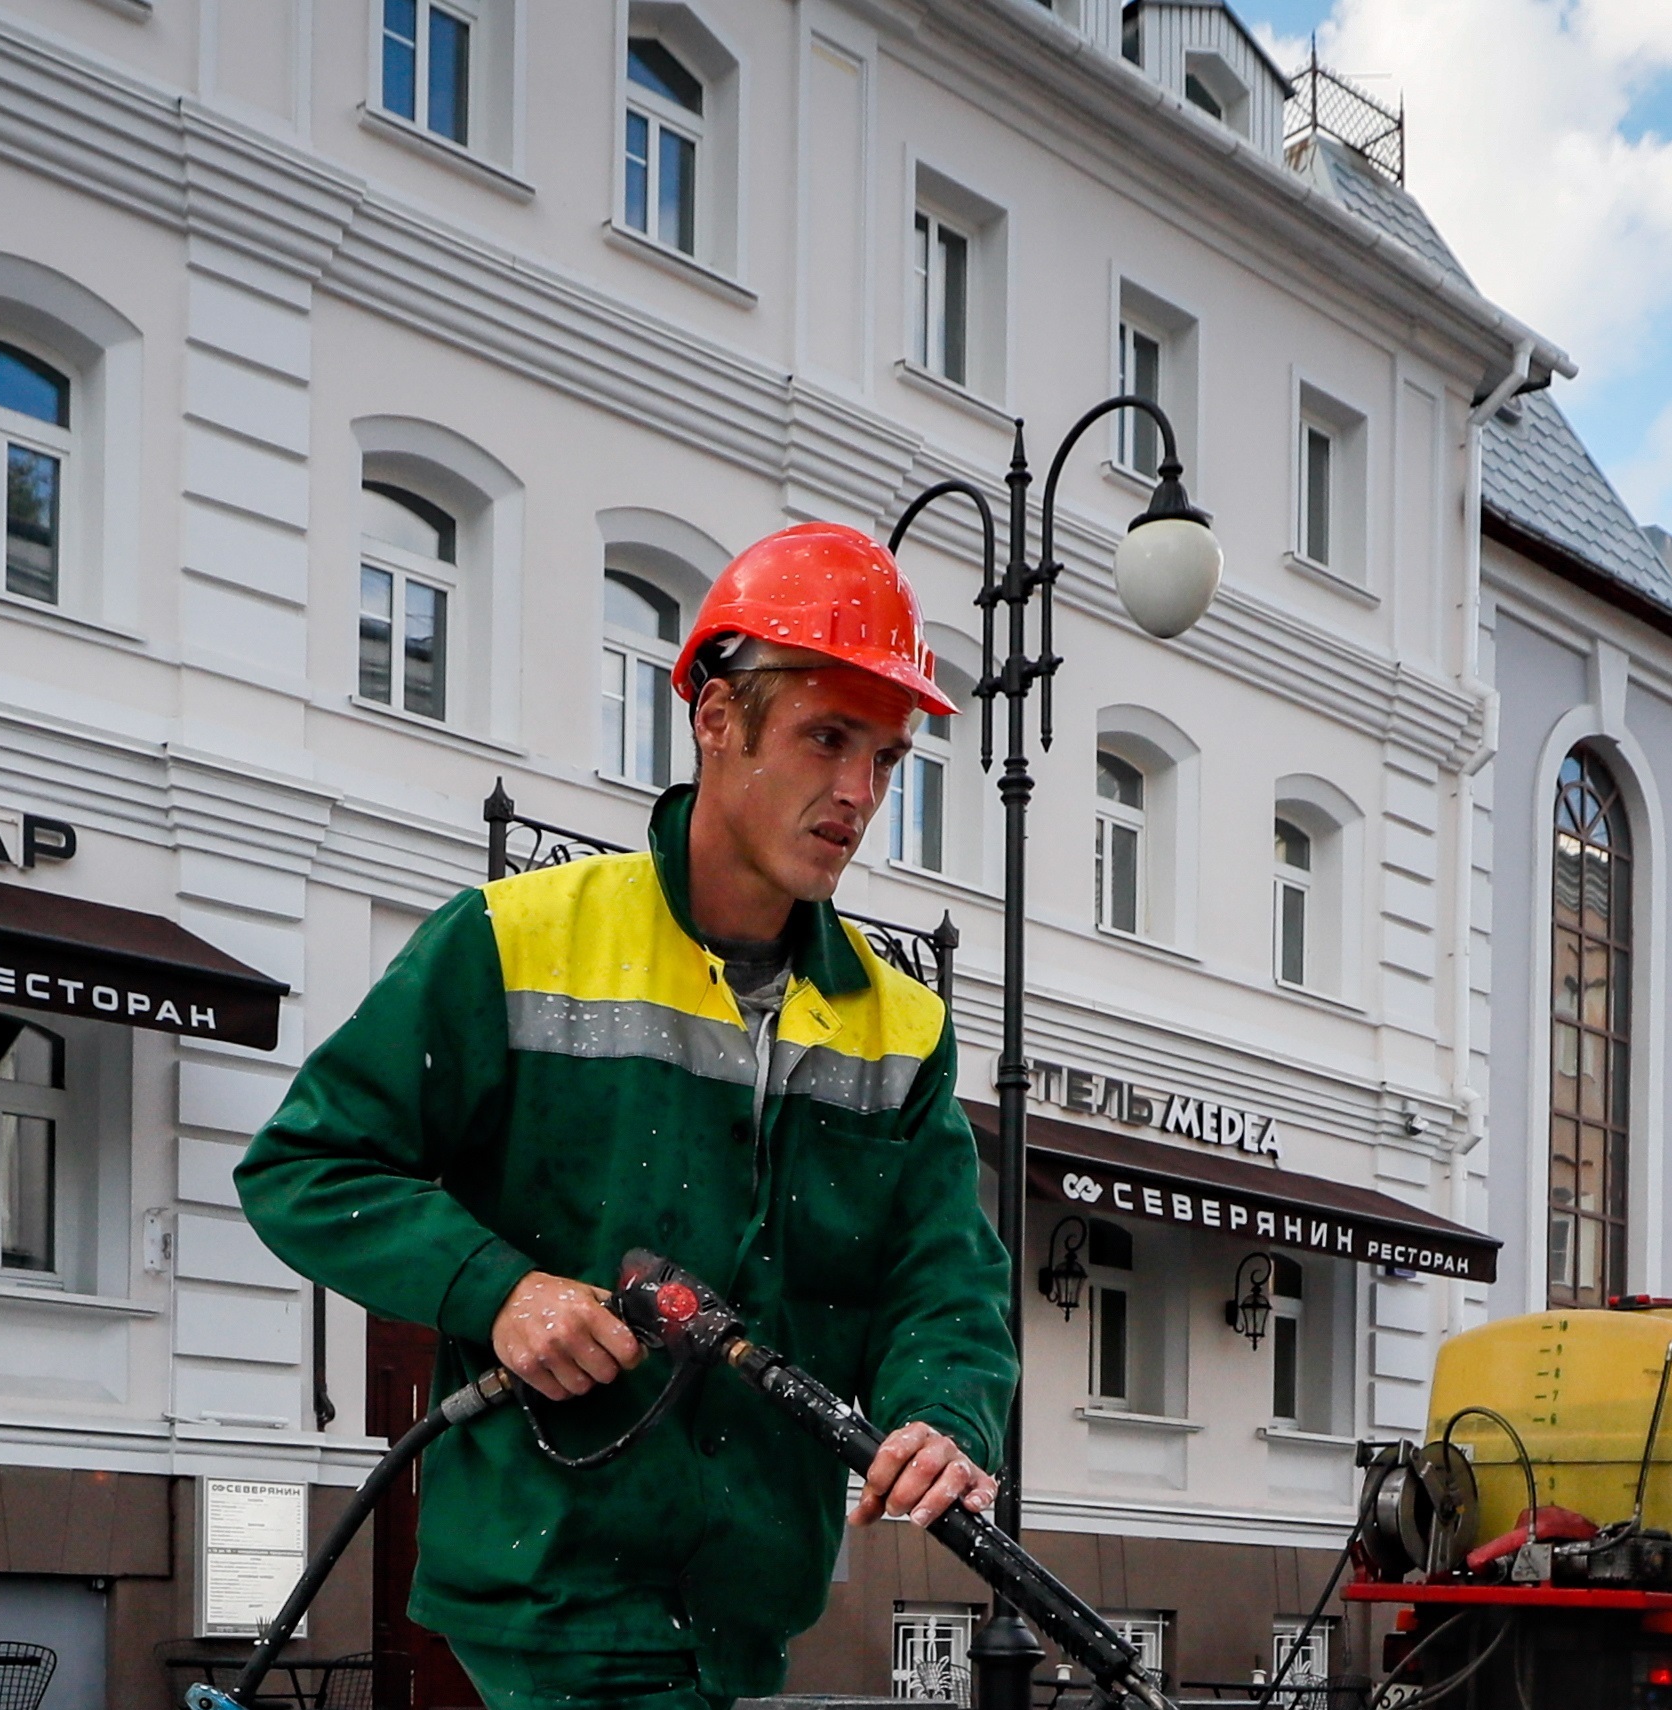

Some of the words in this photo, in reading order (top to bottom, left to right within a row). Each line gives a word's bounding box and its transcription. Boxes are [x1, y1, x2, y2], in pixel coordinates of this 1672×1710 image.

[992, 1050, 1153, 1127] ТЕЛЬ
[1112, 1181, 1354, 1253] СЕВЕРЯНИН
[1366, 1239, 1470, 1275] РЕСТОРАН
[226, 1484, 302, 1496] СЕВЕРЯНИН
